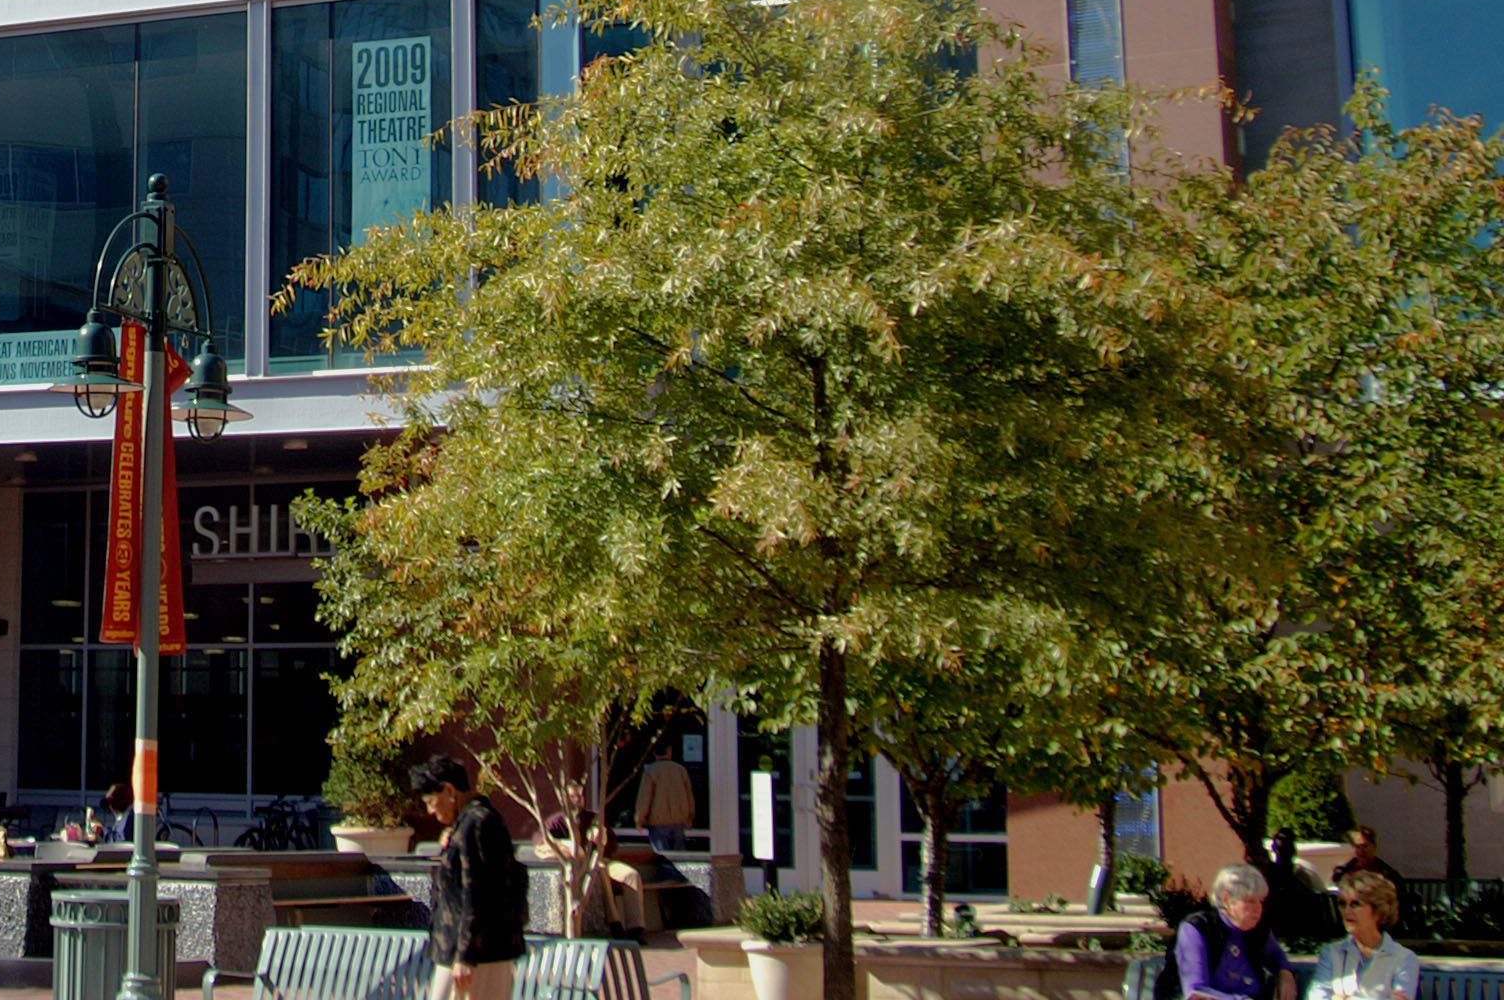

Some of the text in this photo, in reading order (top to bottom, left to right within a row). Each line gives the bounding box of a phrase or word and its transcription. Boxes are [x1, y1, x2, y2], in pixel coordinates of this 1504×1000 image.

[357, 43, 426, 89] 2009
[357, 89, 426, 115] REGIONAL
[358, 116, 426, 145] THEATRE
[358, 146, 423, 168] TONY
[360, 167, 422, 184] AWARD
[16, 338, 68, 358] AMERICAN
[20, 360, 73, 379] NOVEMBER
[124, 327, 136, 438] signture
[117, 442, 134, 538] CELEBRATES
[192, 505, 338, 555] SHIR
[112, 570, 131, 622] YEARS
